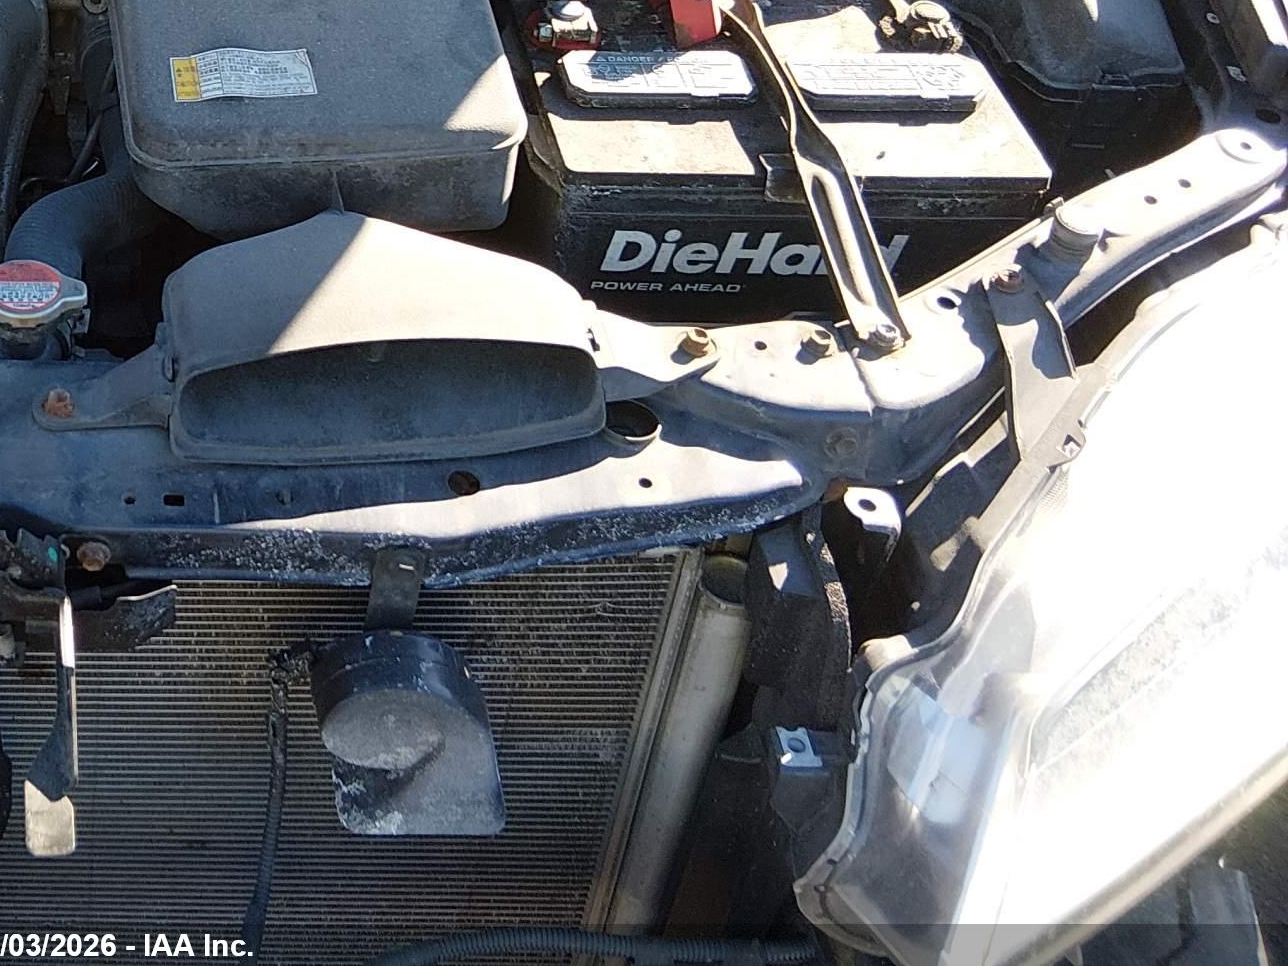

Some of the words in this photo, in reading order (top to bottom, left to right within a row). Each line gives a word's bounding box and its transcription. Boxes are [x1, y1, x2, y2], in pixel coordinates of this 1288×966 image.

[600, 229, 910, 276] DieHad
[590, 280, 664, 292] POWER
[669, 283, 742, 294] AHEAD
